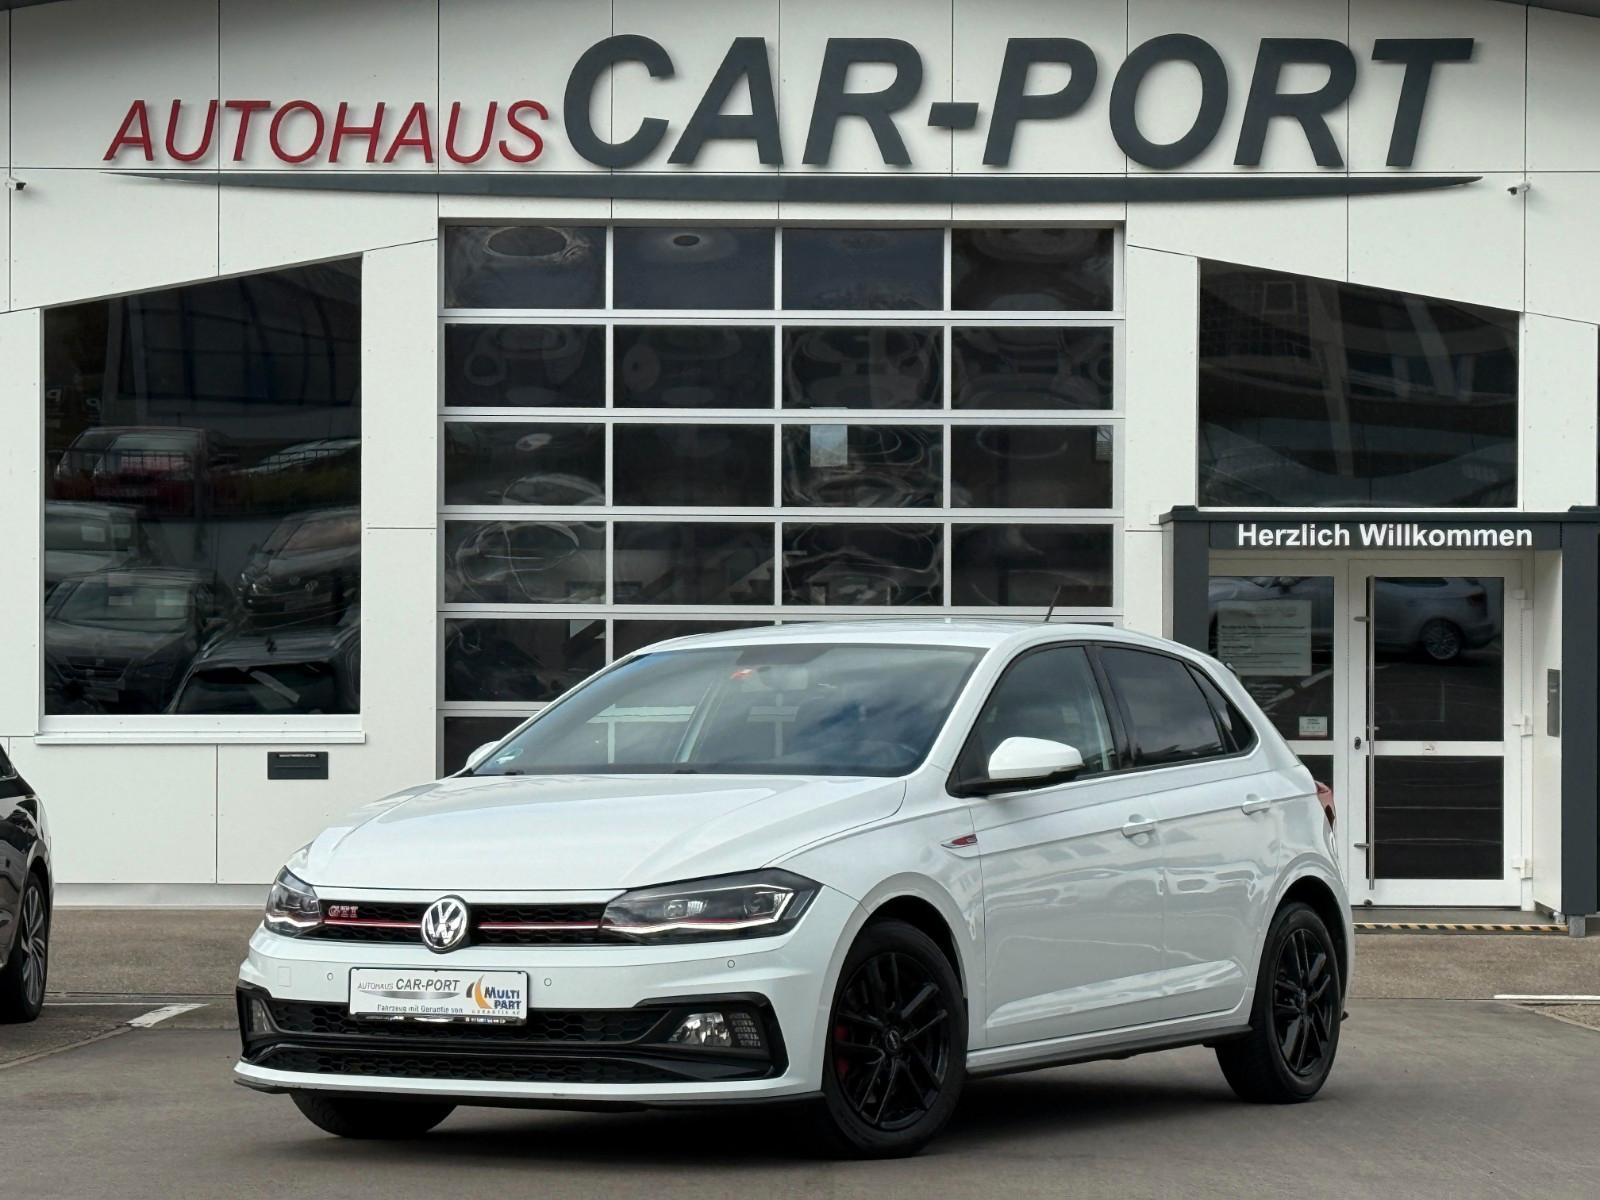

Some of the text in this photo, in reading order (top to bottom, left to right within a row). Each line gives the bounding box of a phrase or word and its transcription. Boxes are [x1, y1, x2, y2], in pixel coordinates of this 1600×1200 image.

[103, 33, 1474, 169] AUTOHAUS CAR-PORT
[1238, 523, 1533, 547] Herzlich Willkommen
[328, 904, 359, 918] GTI
[358, 978, 461, 991] AUTOHAUS CAR-PORT
[484, 986, 520, 999] MULTI
[408, 1004, 419, 1012] mit
[494, 1000, 522, 1010] PART
